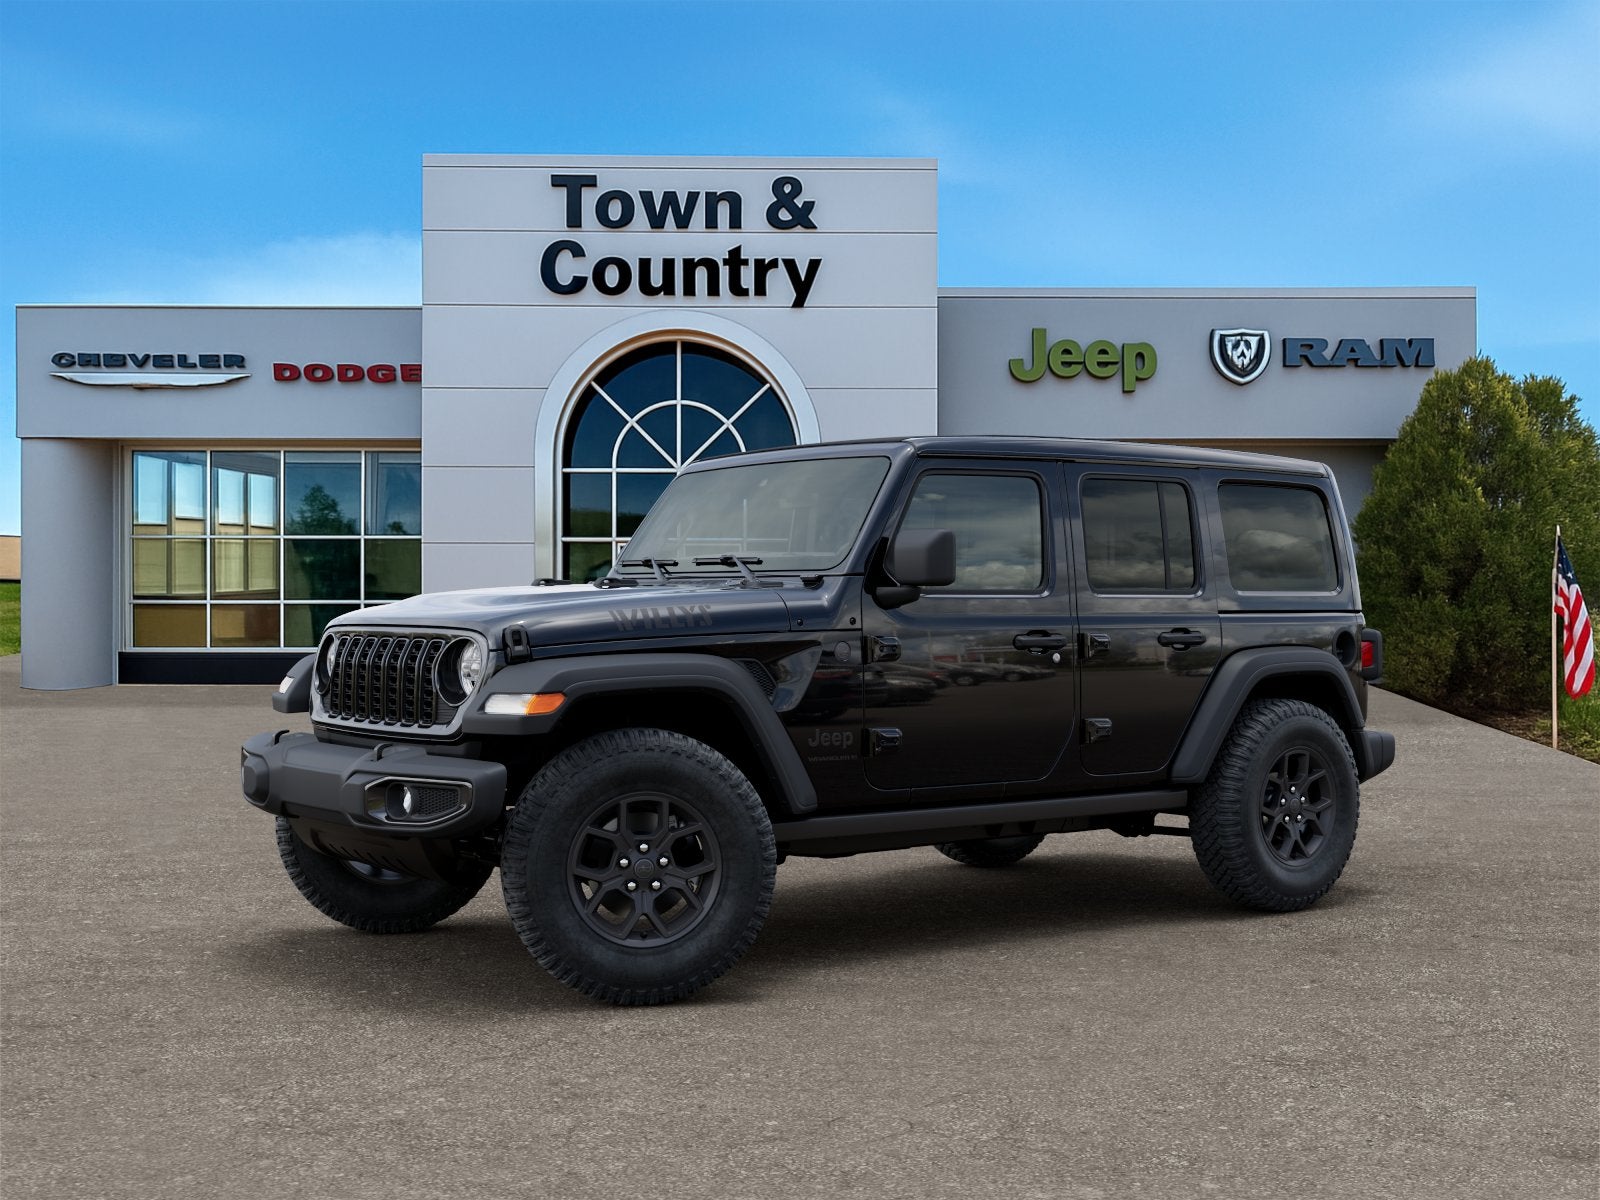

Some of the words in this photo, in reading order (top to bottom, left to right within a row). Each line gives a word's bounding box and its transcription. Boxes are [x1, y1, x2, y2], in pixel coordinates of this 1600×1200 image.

[551, 174, 743, 230] Town
[765, 176, 819, 230] &
[540, 239, 823, 309] Country
[1009, 327, 1157, 393] Jeep
[1282, 337, 1436, 368] RAM
[273, 363, 422, 383] DODGE
[608, 605, 712, 631] WILLYS
[808, 729, 854, 748] Jeep
